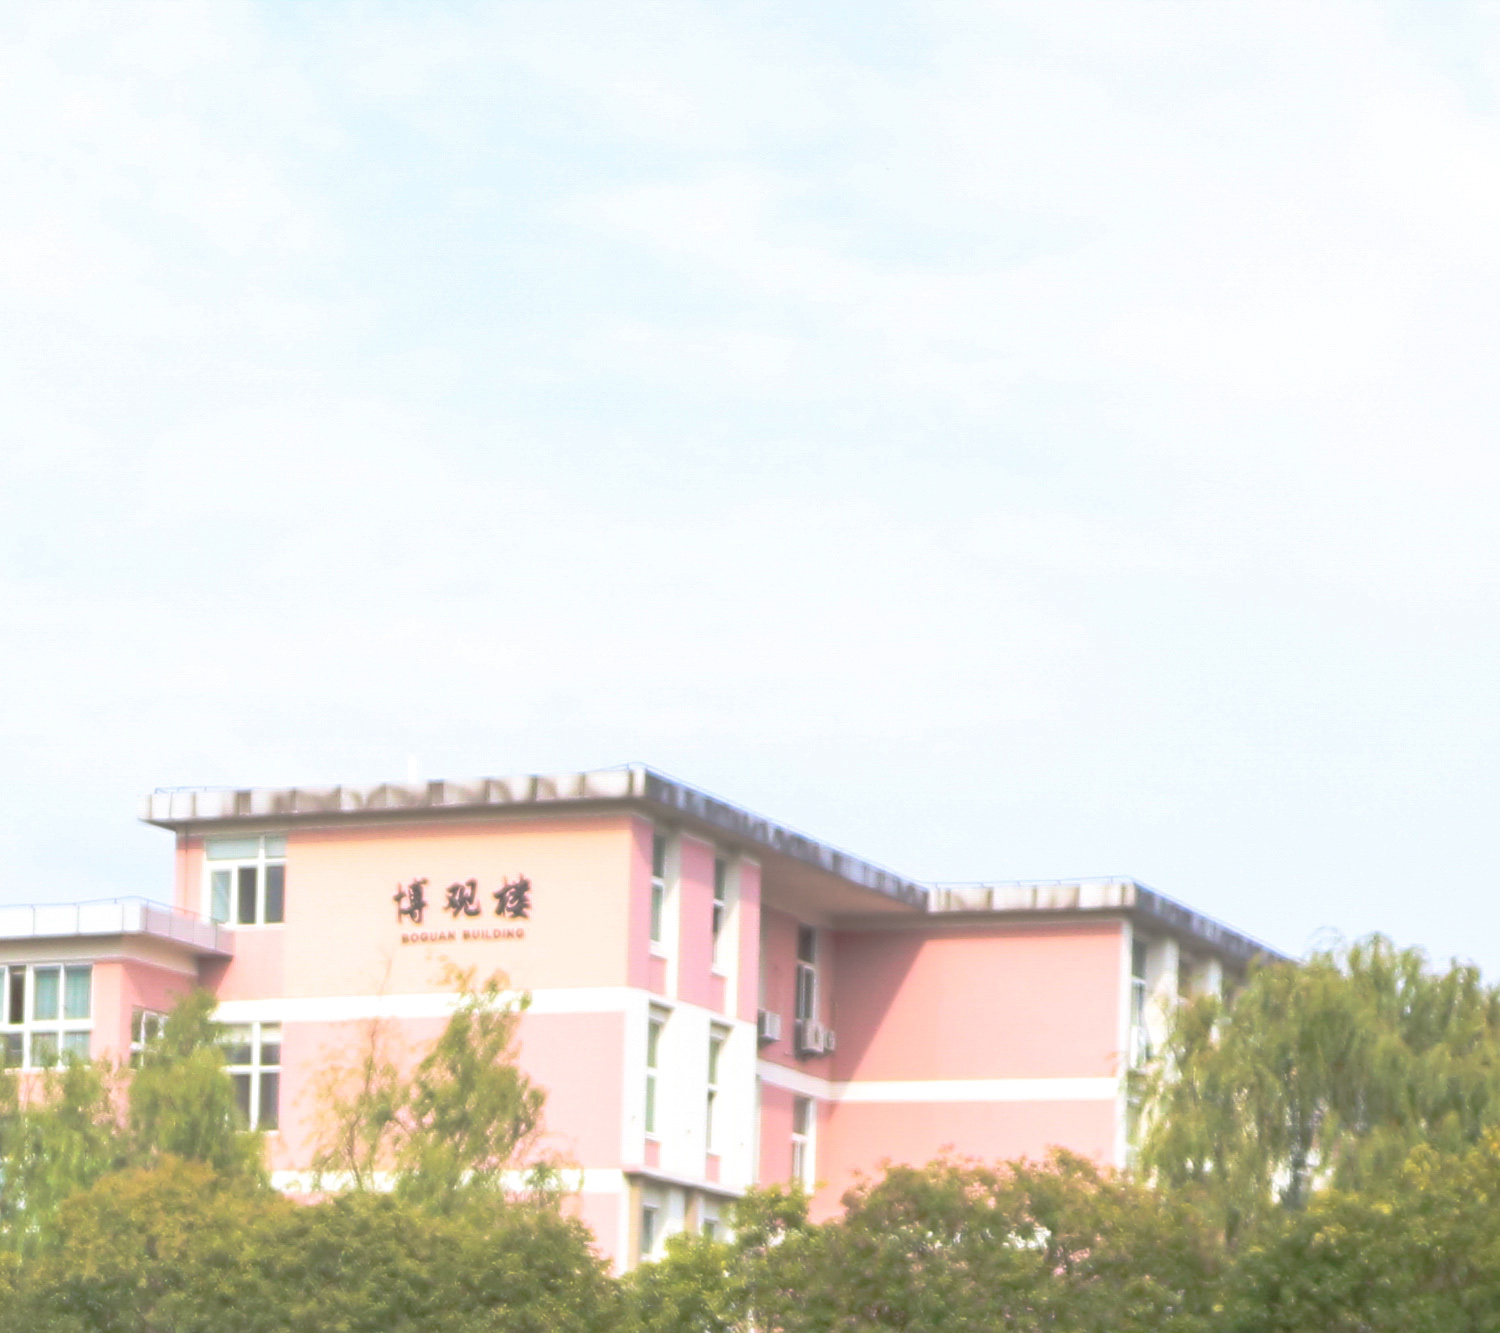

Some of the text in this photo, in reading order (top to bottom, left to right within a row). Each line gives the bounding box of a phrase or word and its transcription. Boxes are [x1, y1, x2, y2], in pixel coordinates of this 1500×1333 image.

[393, 874, 532, 923] 博观楼
[402, 927, 525, 944] BOGUAN BUILDING
